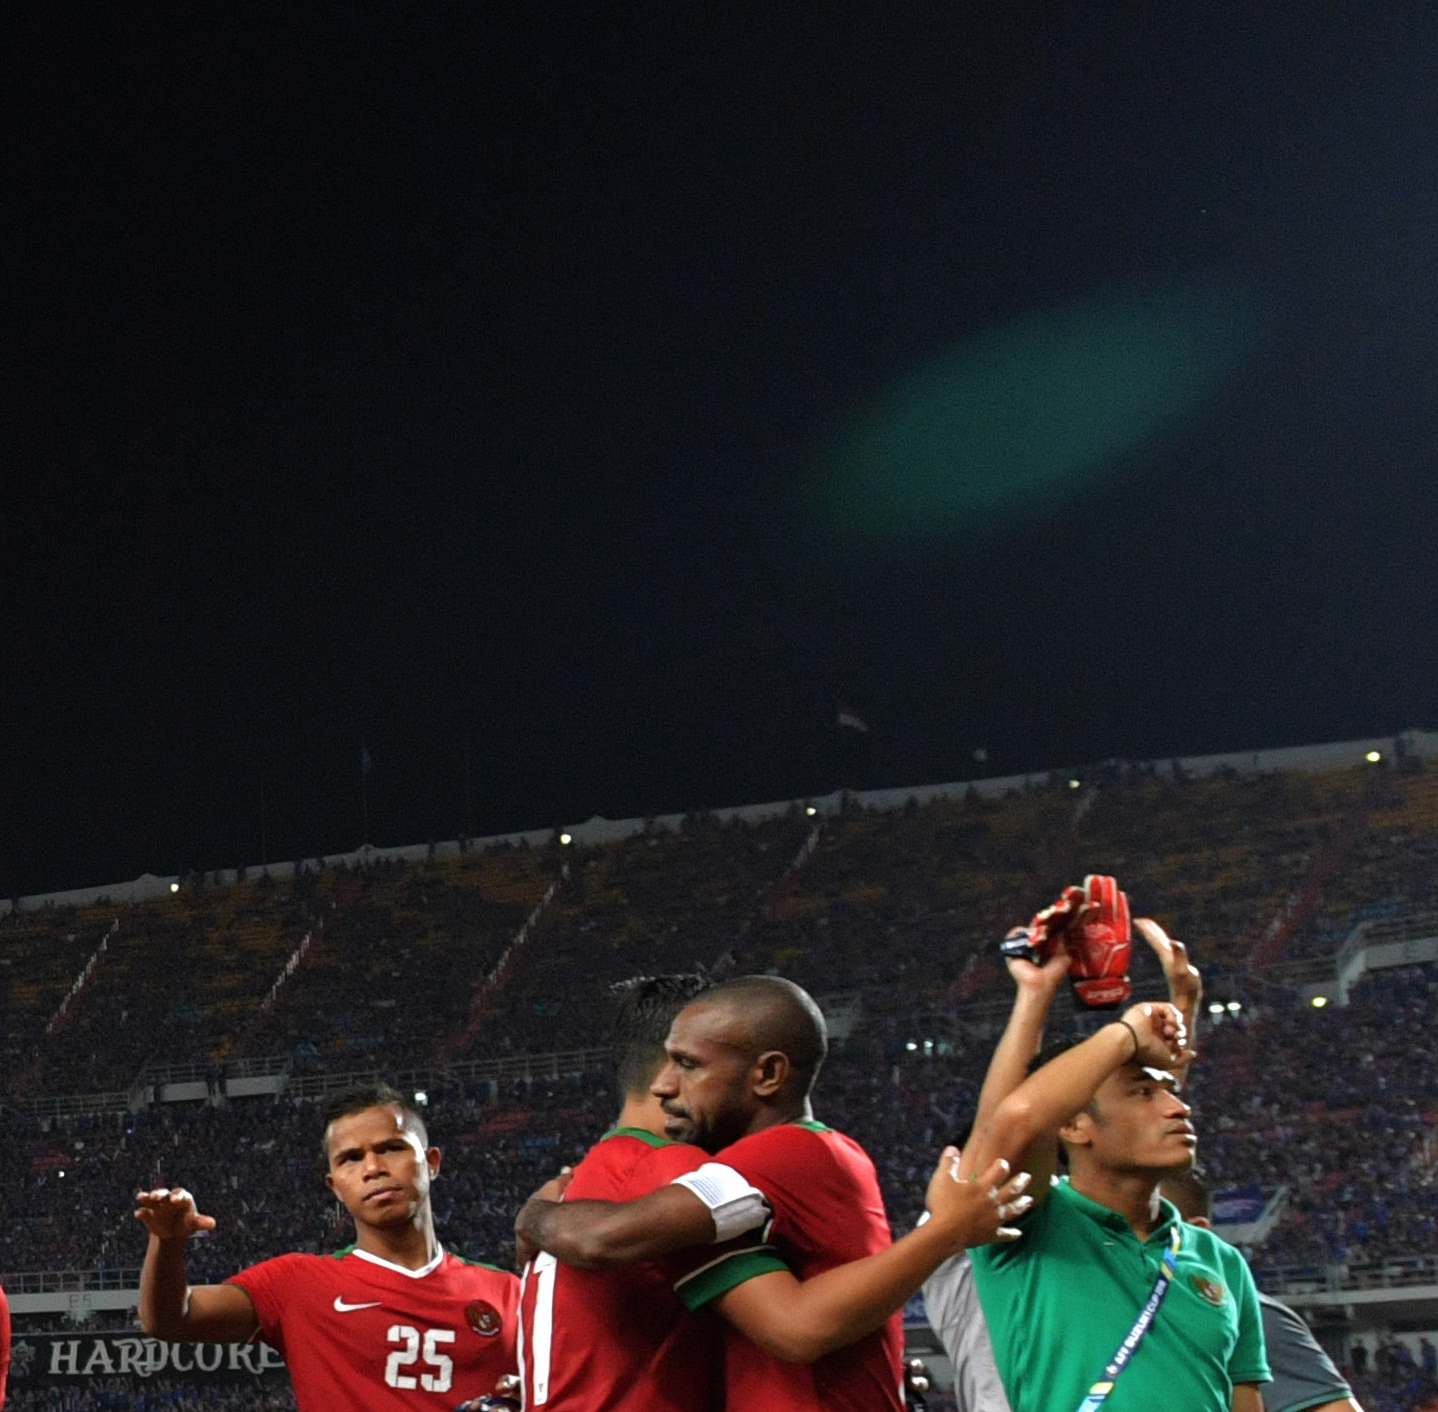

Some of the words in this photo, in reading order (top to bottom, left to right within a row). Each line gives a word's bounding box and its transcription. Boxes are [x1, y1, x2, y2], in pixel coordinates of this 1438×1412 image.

[1124, 1310, 1152, 1348] SUZUKI
[1146, 1293, 1160, 1313] CUP
[48, 1338, 286, 1377] HARDCORE
[385, 1324, 455, 1393] 25
